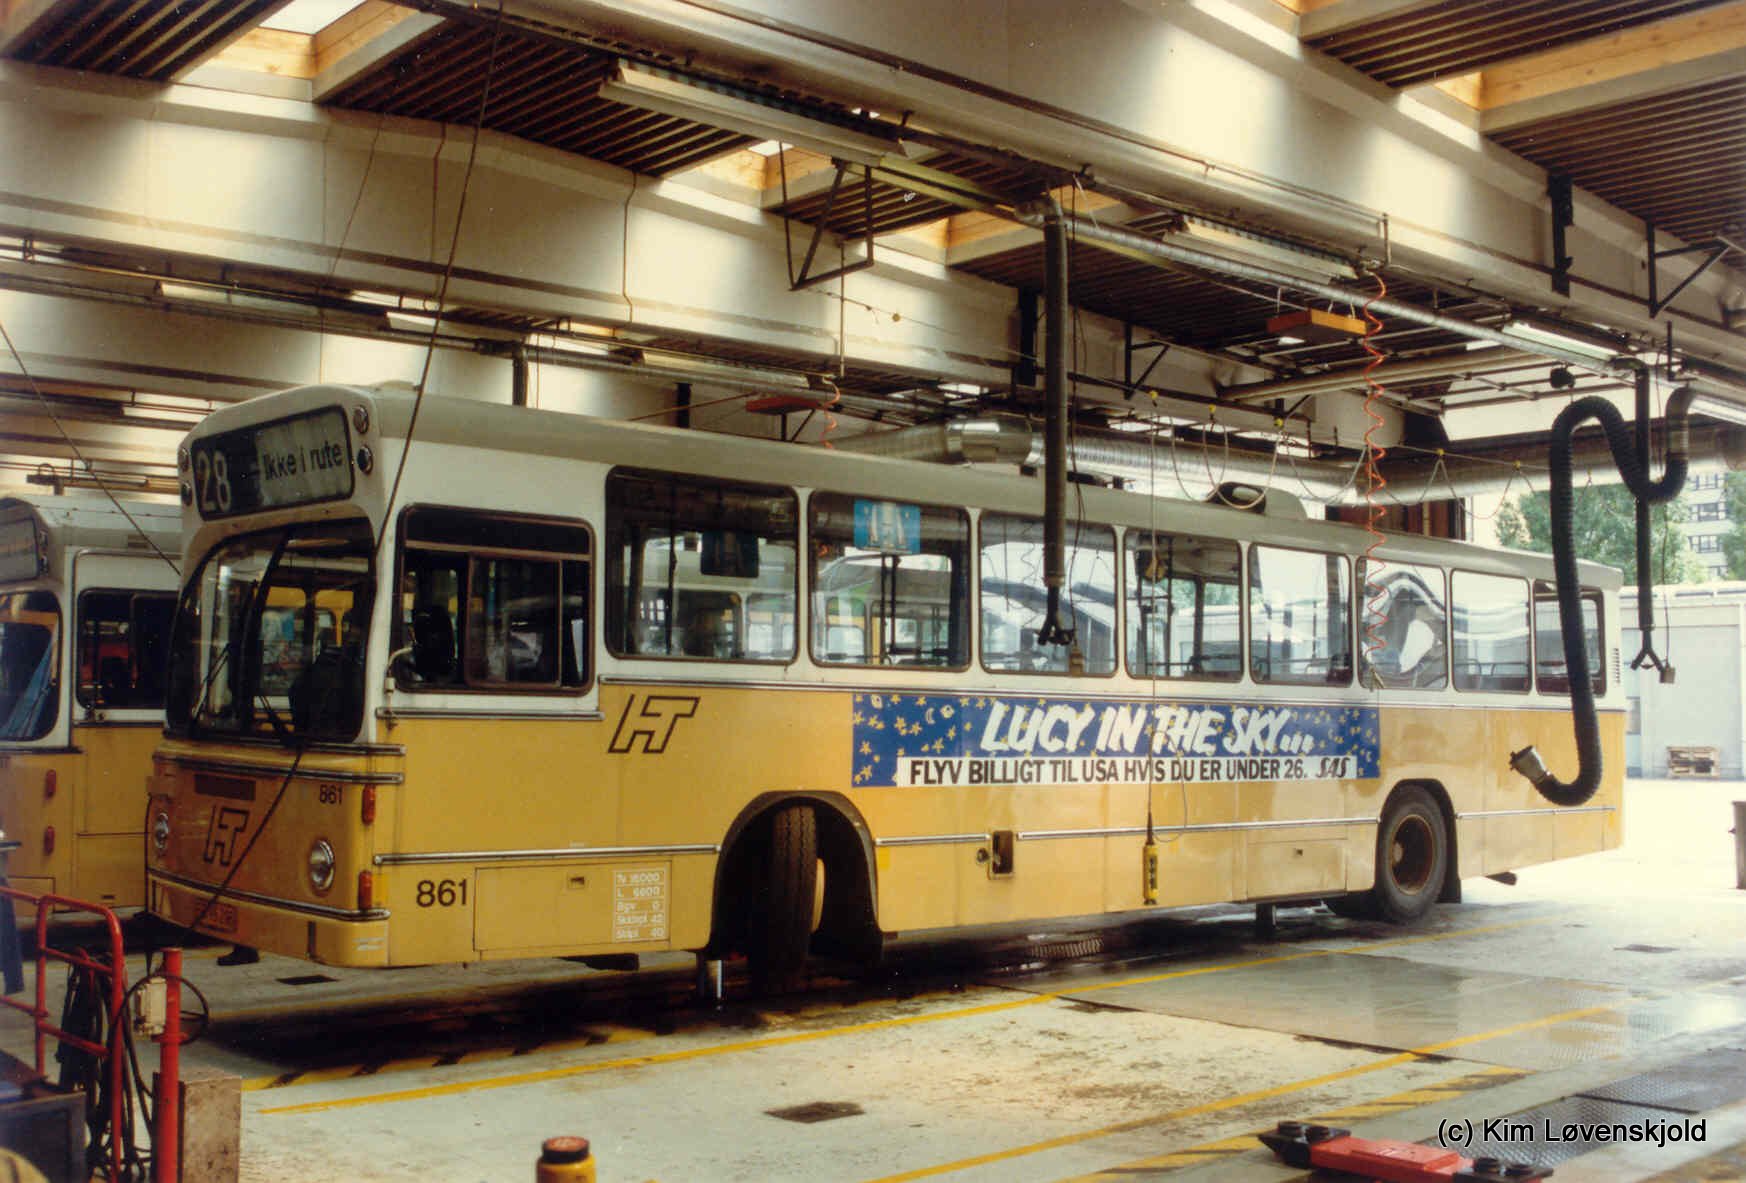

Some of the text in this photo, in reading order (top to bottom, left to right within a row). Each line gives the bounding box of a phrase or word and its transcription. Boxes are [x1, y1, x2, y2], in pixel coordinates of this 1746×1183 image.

[310, 440, 343, 471] rute
[198, 450, 231, 512] 28
[607, 693, 700, 754] HT
[980, 699, 1096, 752] LUCY
[1095, 705, 1147, 754] IN
[1151, 705, 1226, 754] THE
[911, 756, 1350, 786] FLYV BILLIGT TIL USA HVIS DU ER UNDER 26. SAS
[319, 785, 342, 804] 861
[416, 878, 468, 908] 861
